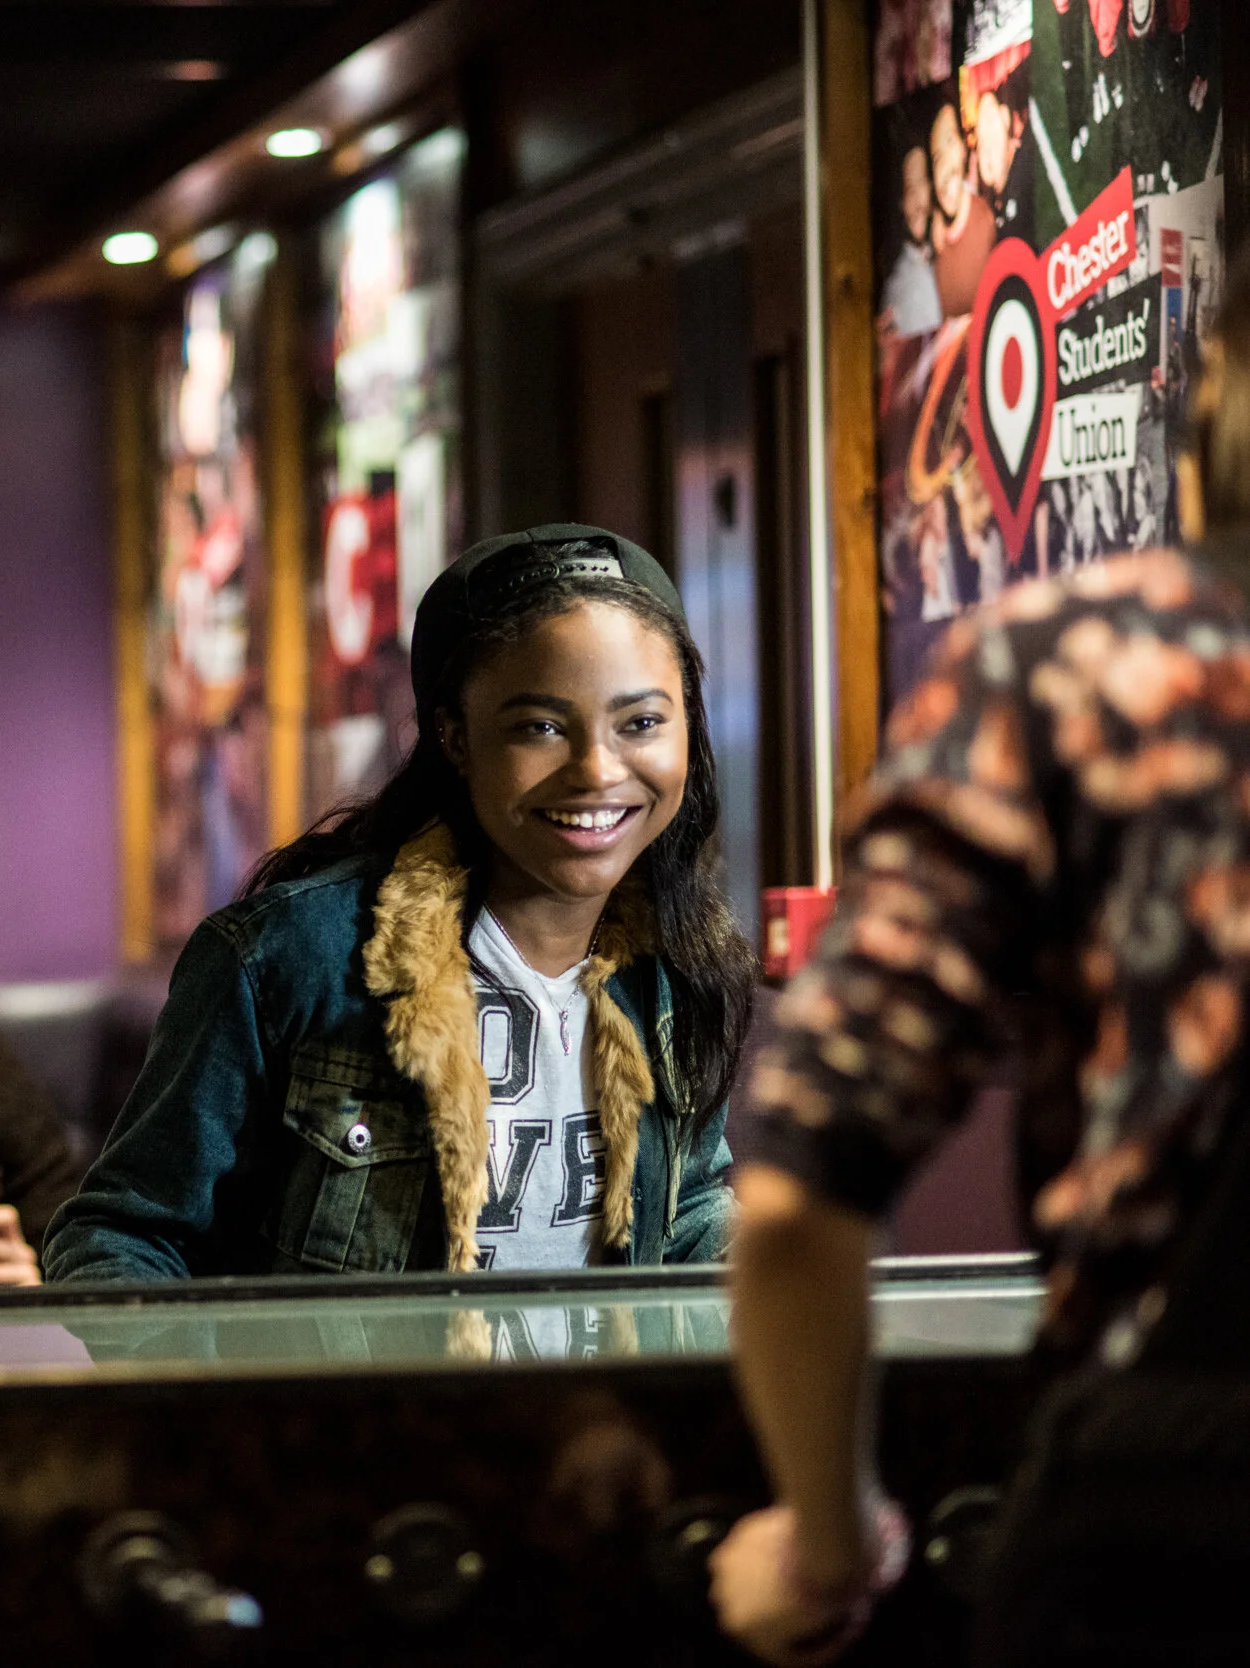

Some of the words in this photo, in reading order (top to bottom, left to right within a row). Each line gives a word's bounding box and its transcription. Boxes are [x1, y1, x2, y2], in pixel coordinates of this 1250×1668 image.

[1047, 211, 1129, 309] Chester
[1058, 298, 1150, 385] Students'
[1058, 404, 1126, 467] Union
